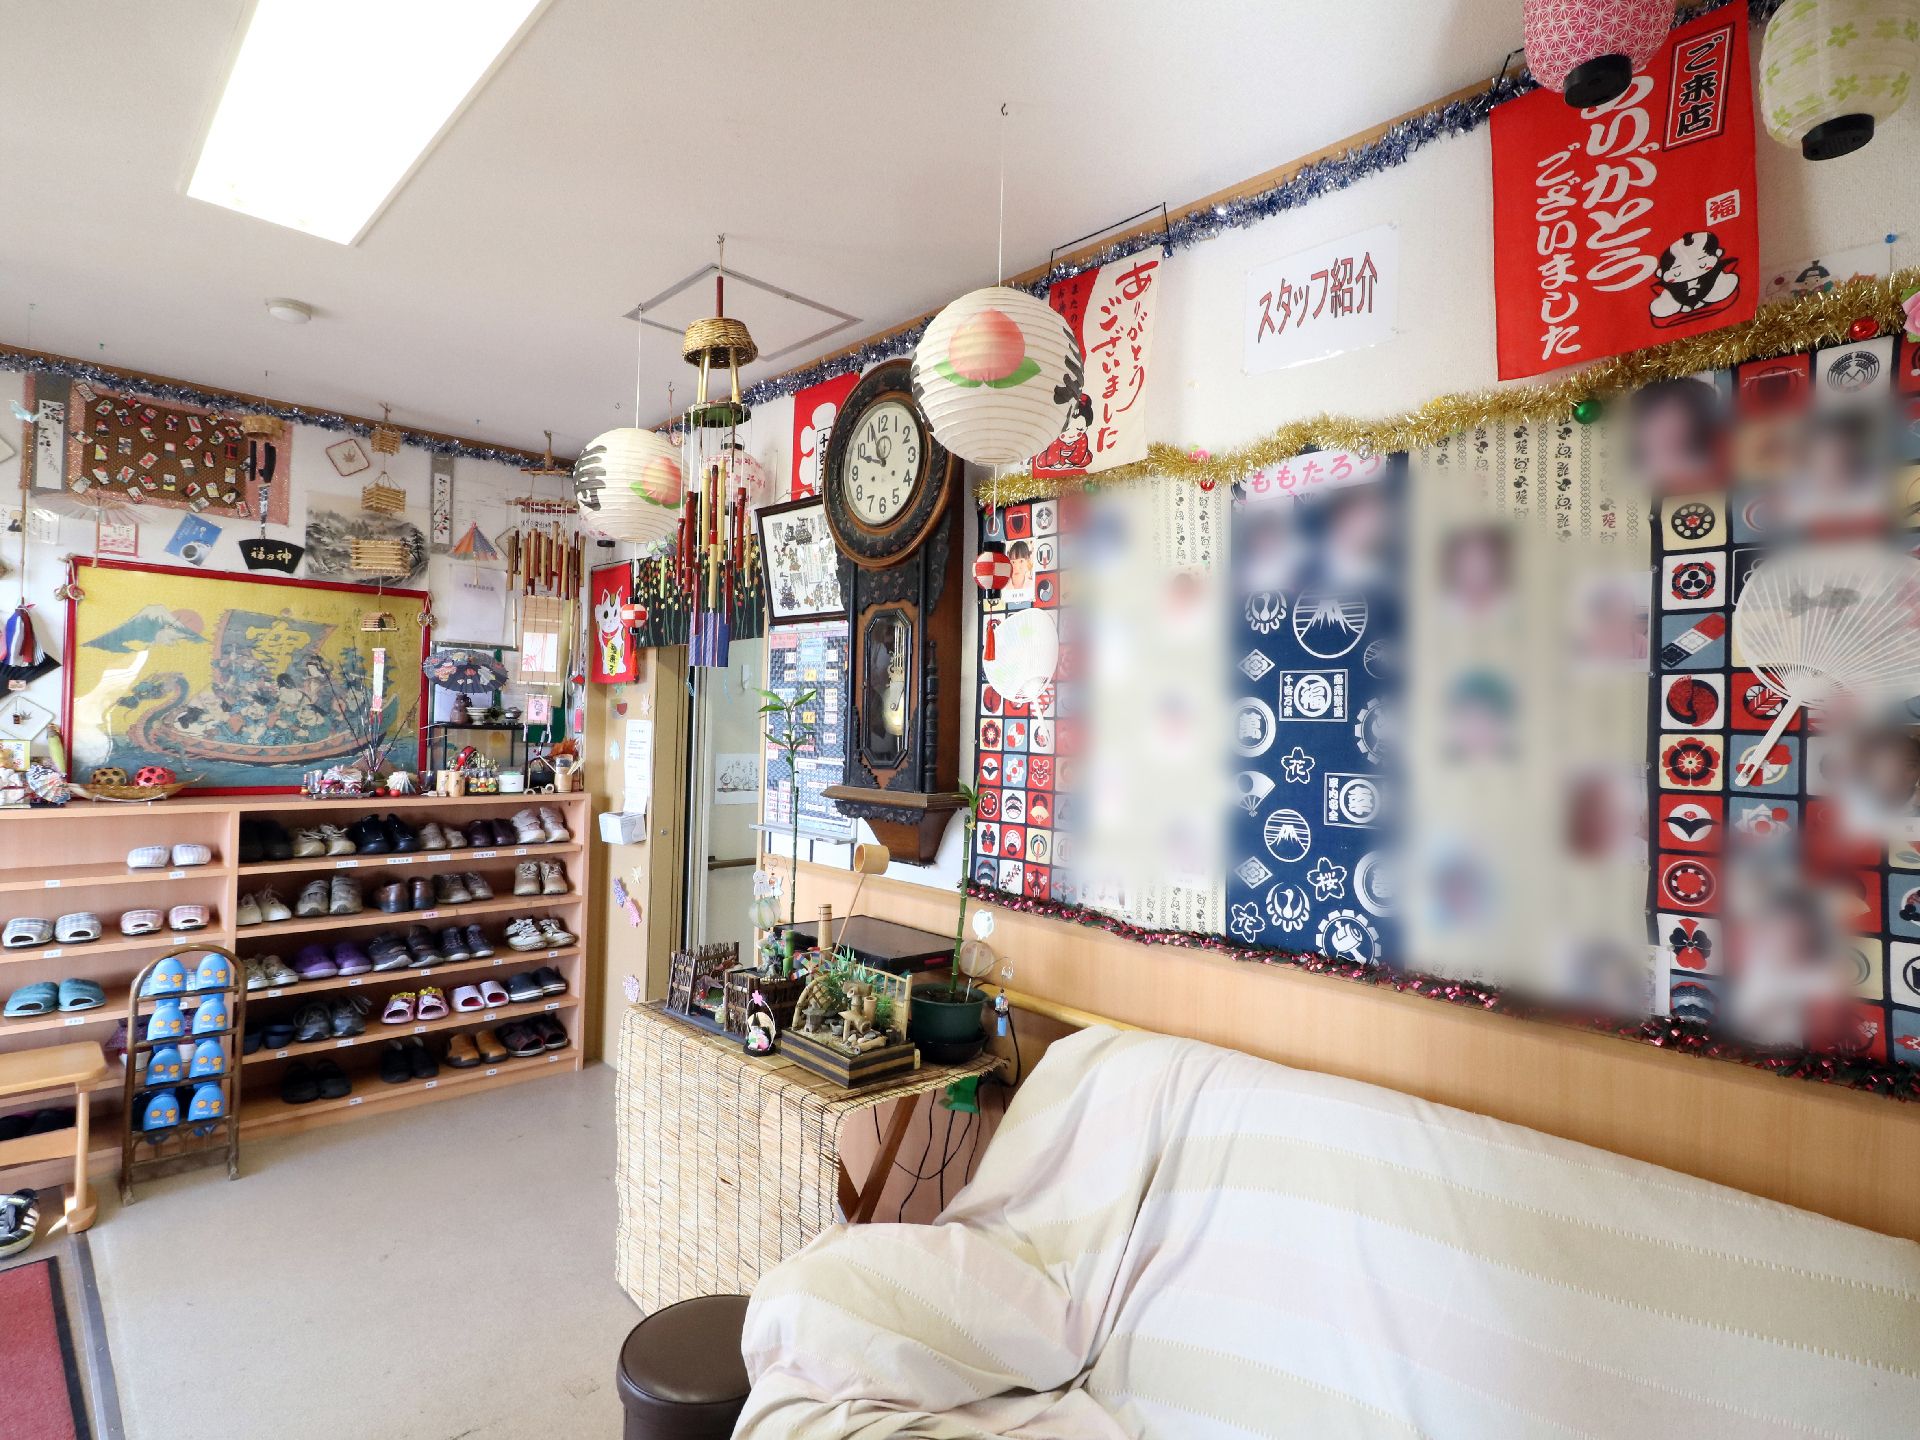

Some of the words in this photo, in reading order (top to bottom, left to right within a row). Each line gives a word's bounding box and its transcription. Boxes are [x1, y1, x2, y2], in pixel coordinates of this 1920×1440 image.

[1675, 33, 1725, 139] ご来店
[1708, 195, 1736, 222] 福
[1535, 142, 1582, 361] ございました
[1257, 252, 1378, 344] スタッフ紹介
[1115, 260, 1158, 413] ありがとう
[1090, 296, 1125, 453] ございました
[878, 414, 889, 433] 12
[902, 425, 911, 444] 2
[857, 442, 866, 461] 10
[907, 446, 916, 463] 3
[851, 465, 859, 482] 9
[902, 468, 912, 487] 4
[1251, 453, 1381, 494] ももたろう
[856, 484, 863, 501] 8
[892, 487, 900, 505] 5
[866, 494, 875, 513] 7
[878, 496, 887, 514] 6
[1288, 759, 1306, 776] 花
[1315, 872, 1338, 892] 桜
